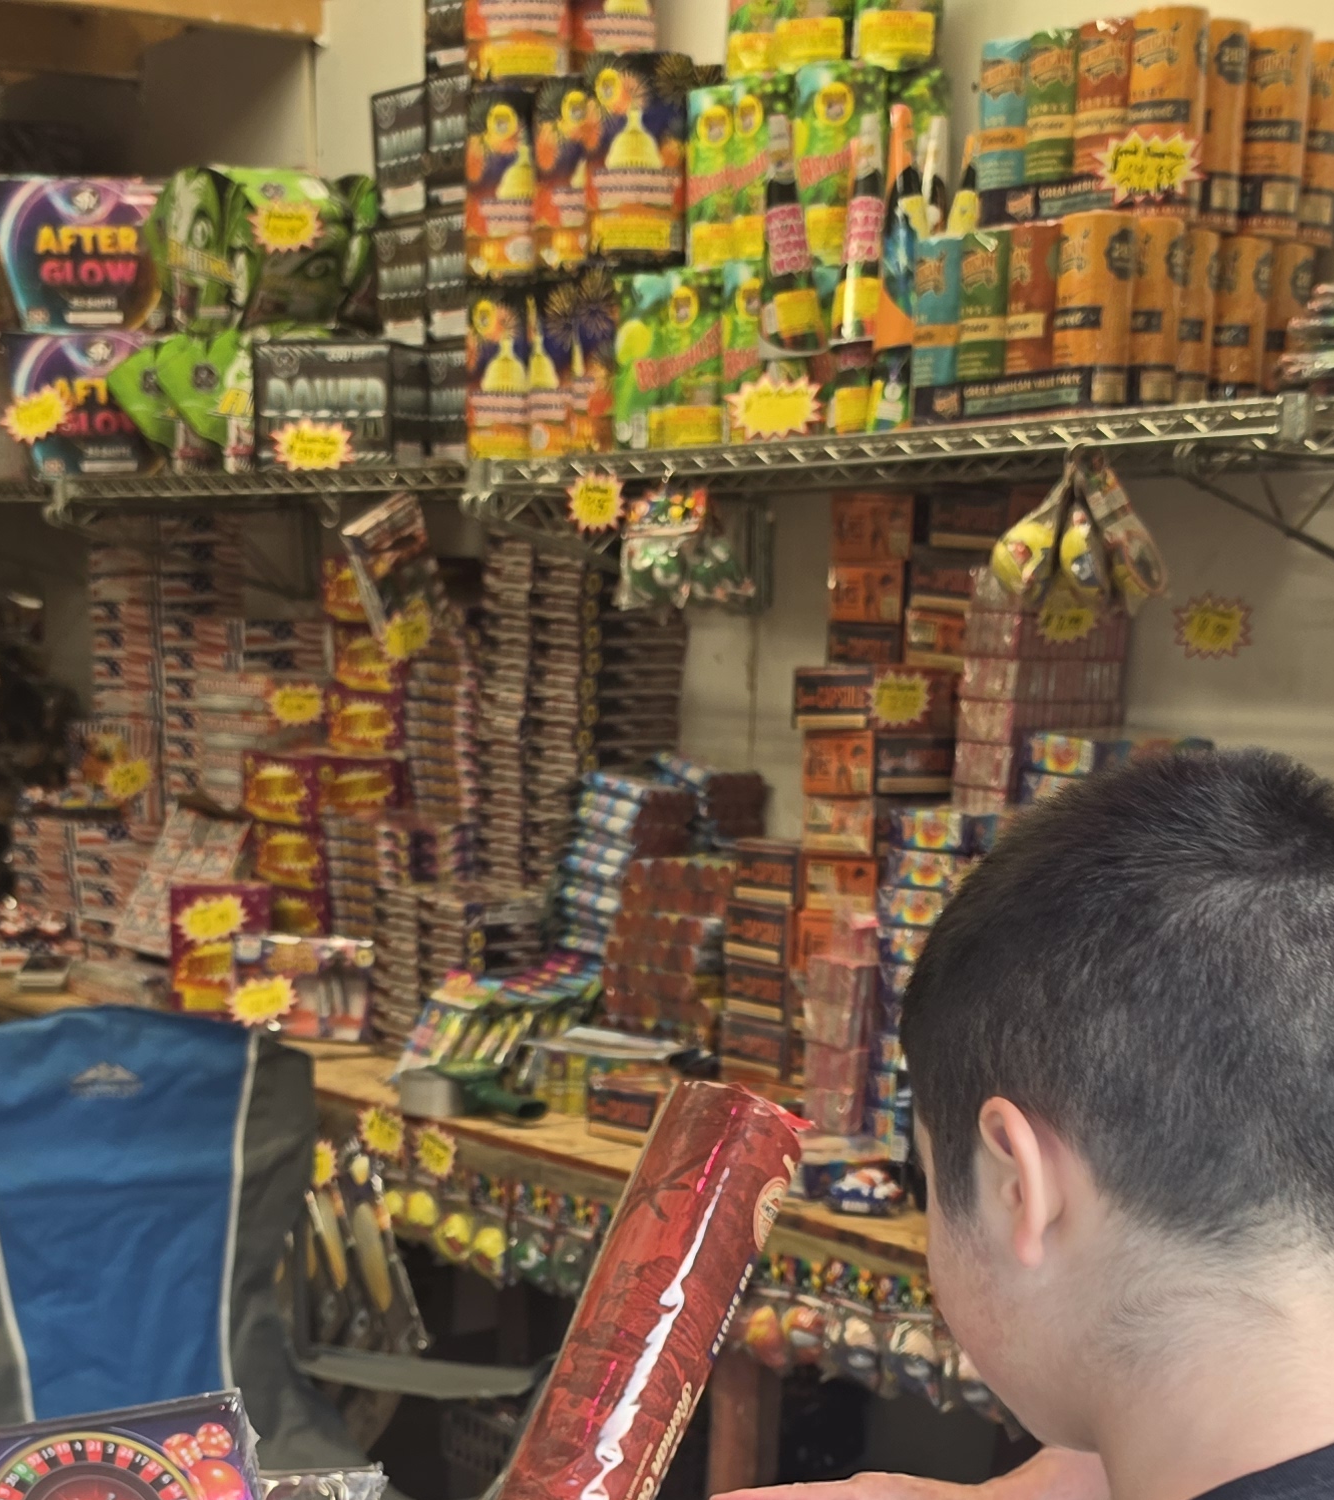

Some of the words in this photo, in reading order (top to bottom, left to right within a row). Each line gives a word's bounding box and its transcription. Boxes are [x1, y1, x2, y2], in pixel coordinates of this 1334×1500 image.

[35, 224, 138, 255] AFTER
[40, 259, 138, 285] GLOW
[54, 377, 109, 406] AFT
[712, 1293, 740, 1356] SHOTS
[650, 1381, 693, 1477] Roman
